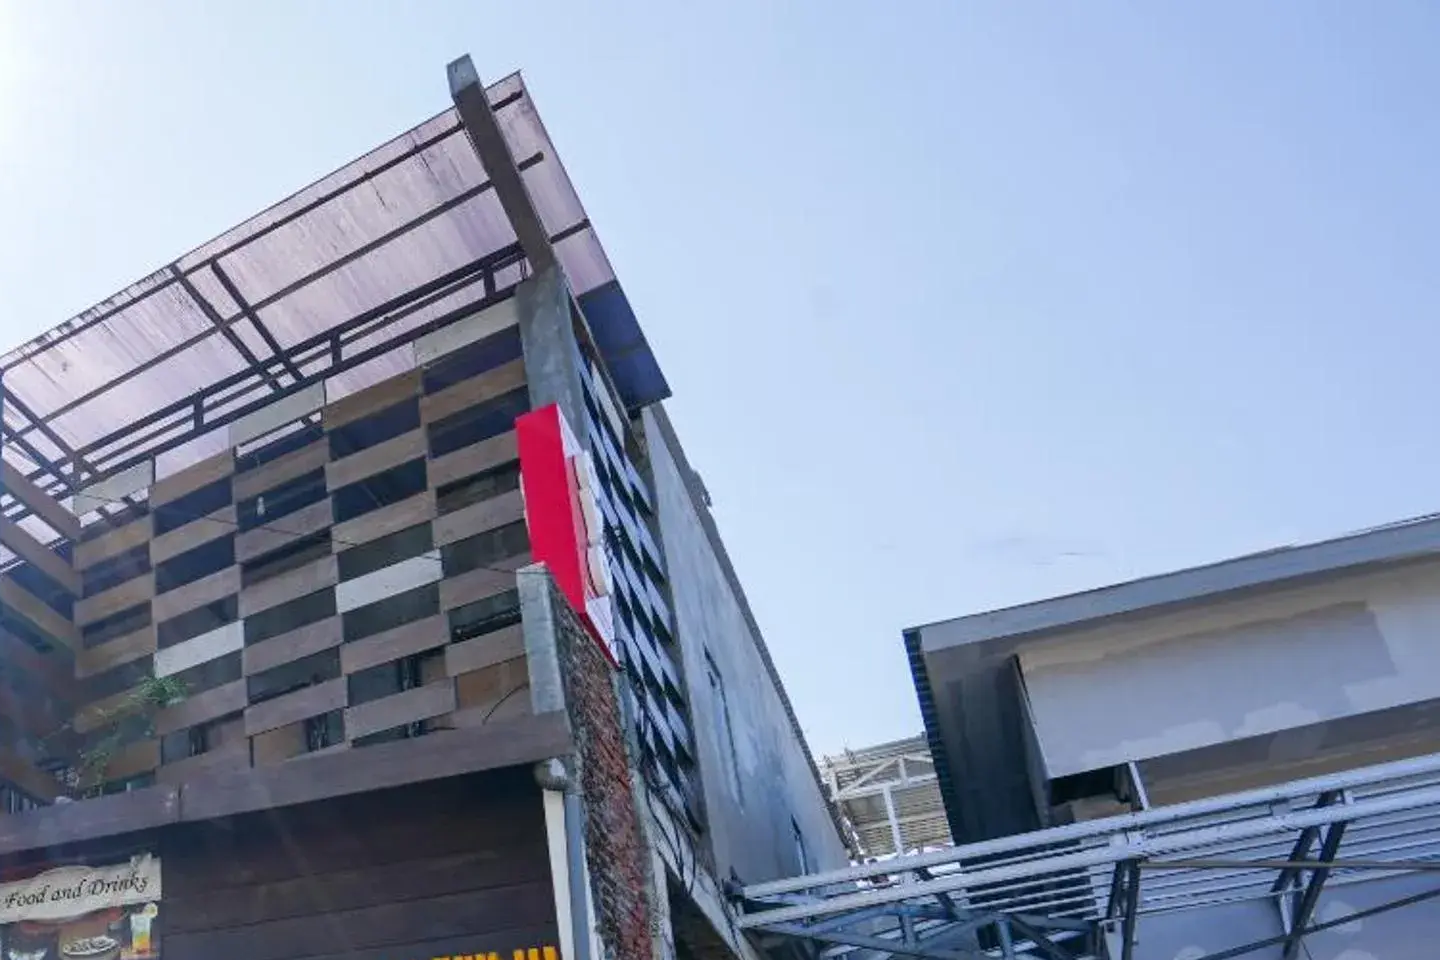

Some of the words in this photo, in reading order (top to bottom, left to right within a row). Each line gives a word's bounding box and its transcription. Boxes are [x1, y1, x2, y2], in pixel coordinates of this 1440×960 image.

[4, 884, 47, 910] Food
[50, 877, 84, 902] and
[87, 867, 150, 898] Drinks
